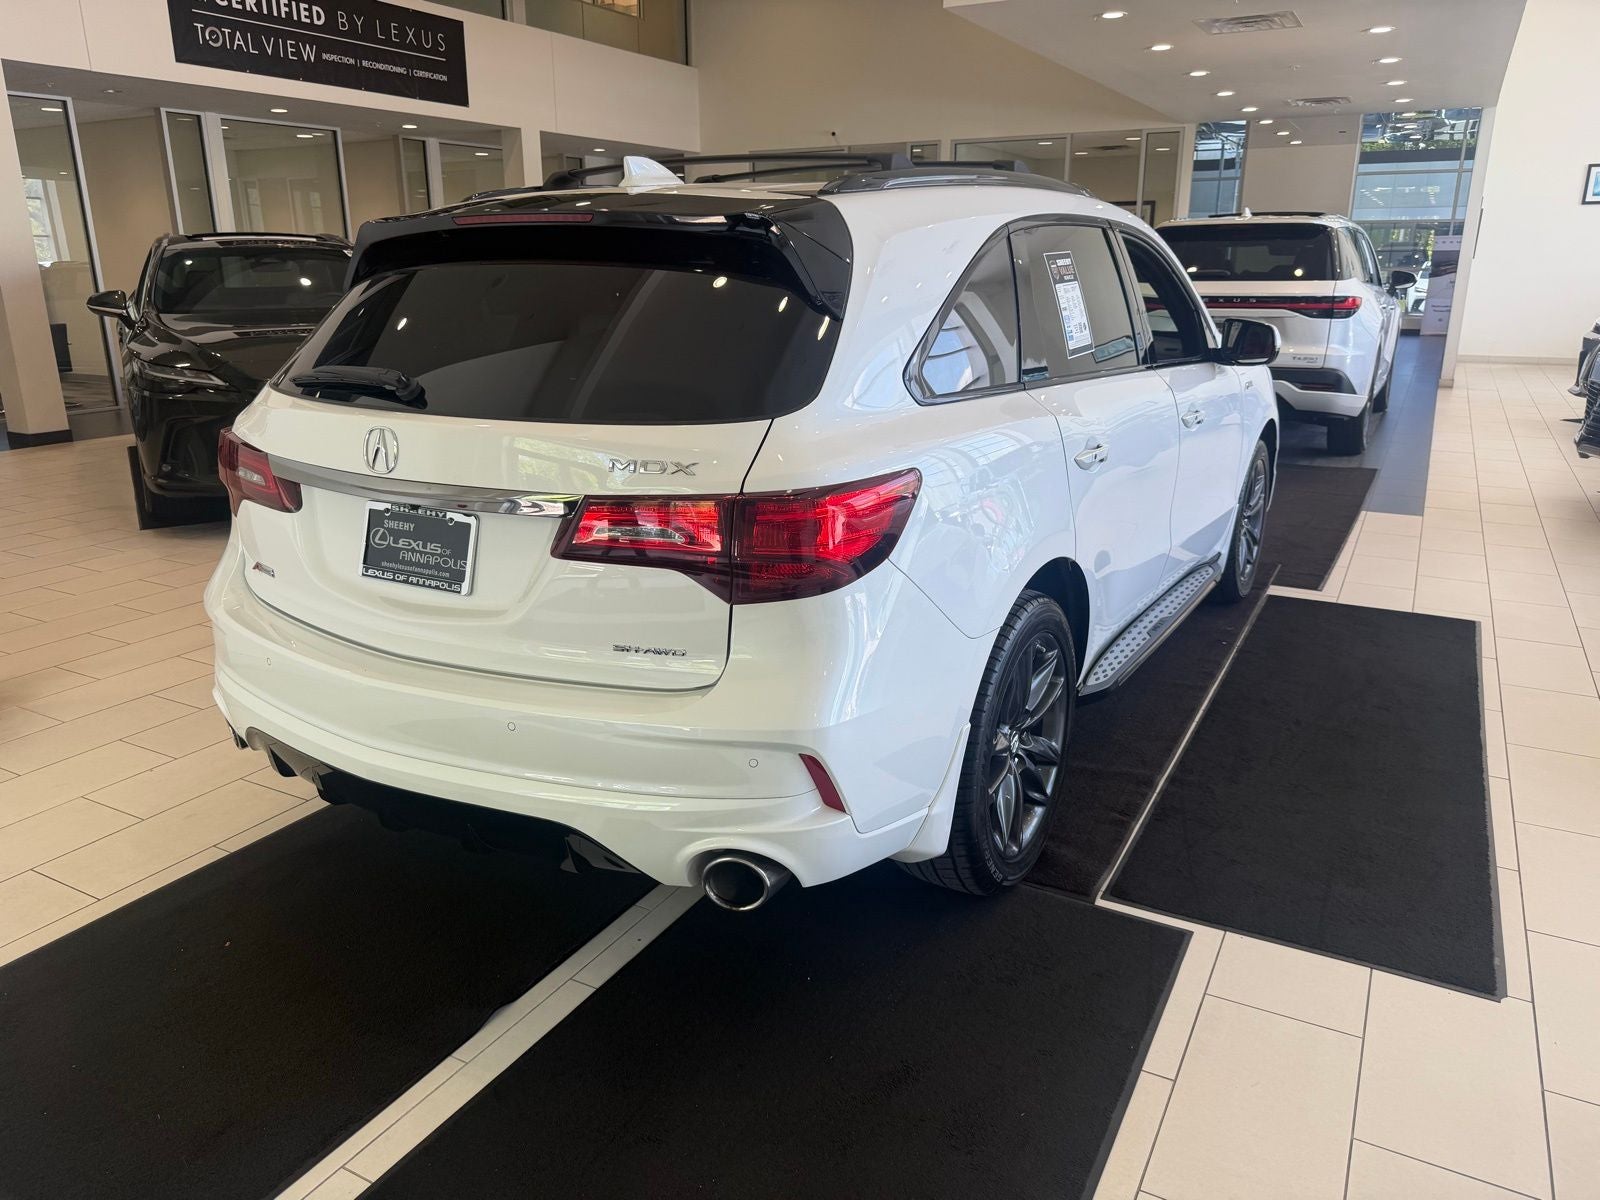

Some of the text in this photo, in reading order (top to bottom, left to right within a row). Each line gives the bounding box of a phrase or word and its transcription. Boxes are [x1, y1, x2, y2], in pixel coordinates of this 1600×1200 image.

[337, 11, 365, 34] BY
[376, 19, 447, 52] LEXUS
[321, 52, 448, 82] INSPECTION RECONDITIONING CERTIFICATION
[608, 458, 700, 477] MDX
[383, 519, 415, 532] SHEEHY
[389, 536, 452, 556] LEXUS OF
[400, 550, 468, 571] ANNAPOLIS
[362, 567, 461, 592] LEXUS OF ANNAPOLIS
